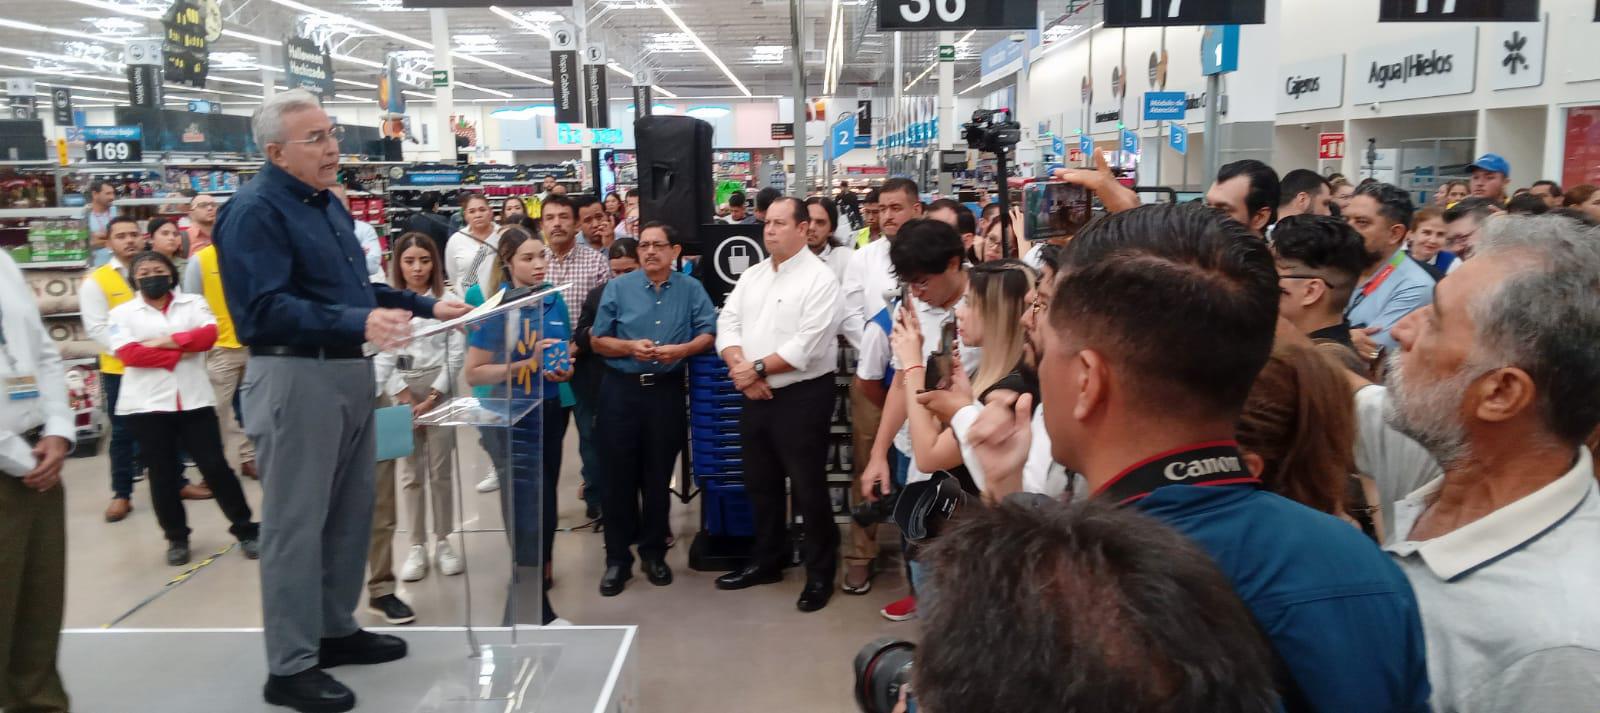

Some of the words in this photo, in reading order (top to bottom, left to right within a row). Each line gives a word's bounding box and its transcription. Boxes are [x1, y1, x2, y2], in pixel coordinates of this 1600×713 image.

[1215, 43, 1223, 66] 1
[1286, 76, 1320, 99] Cajeros
[839, 131, 849, 145] 2
[1125, 137, 1133, 147] 5
[1174, 133, 1182, 144] 3
[1082, 141, 1089, 150] 7
[1164, 456, 1241, 481] Canon
